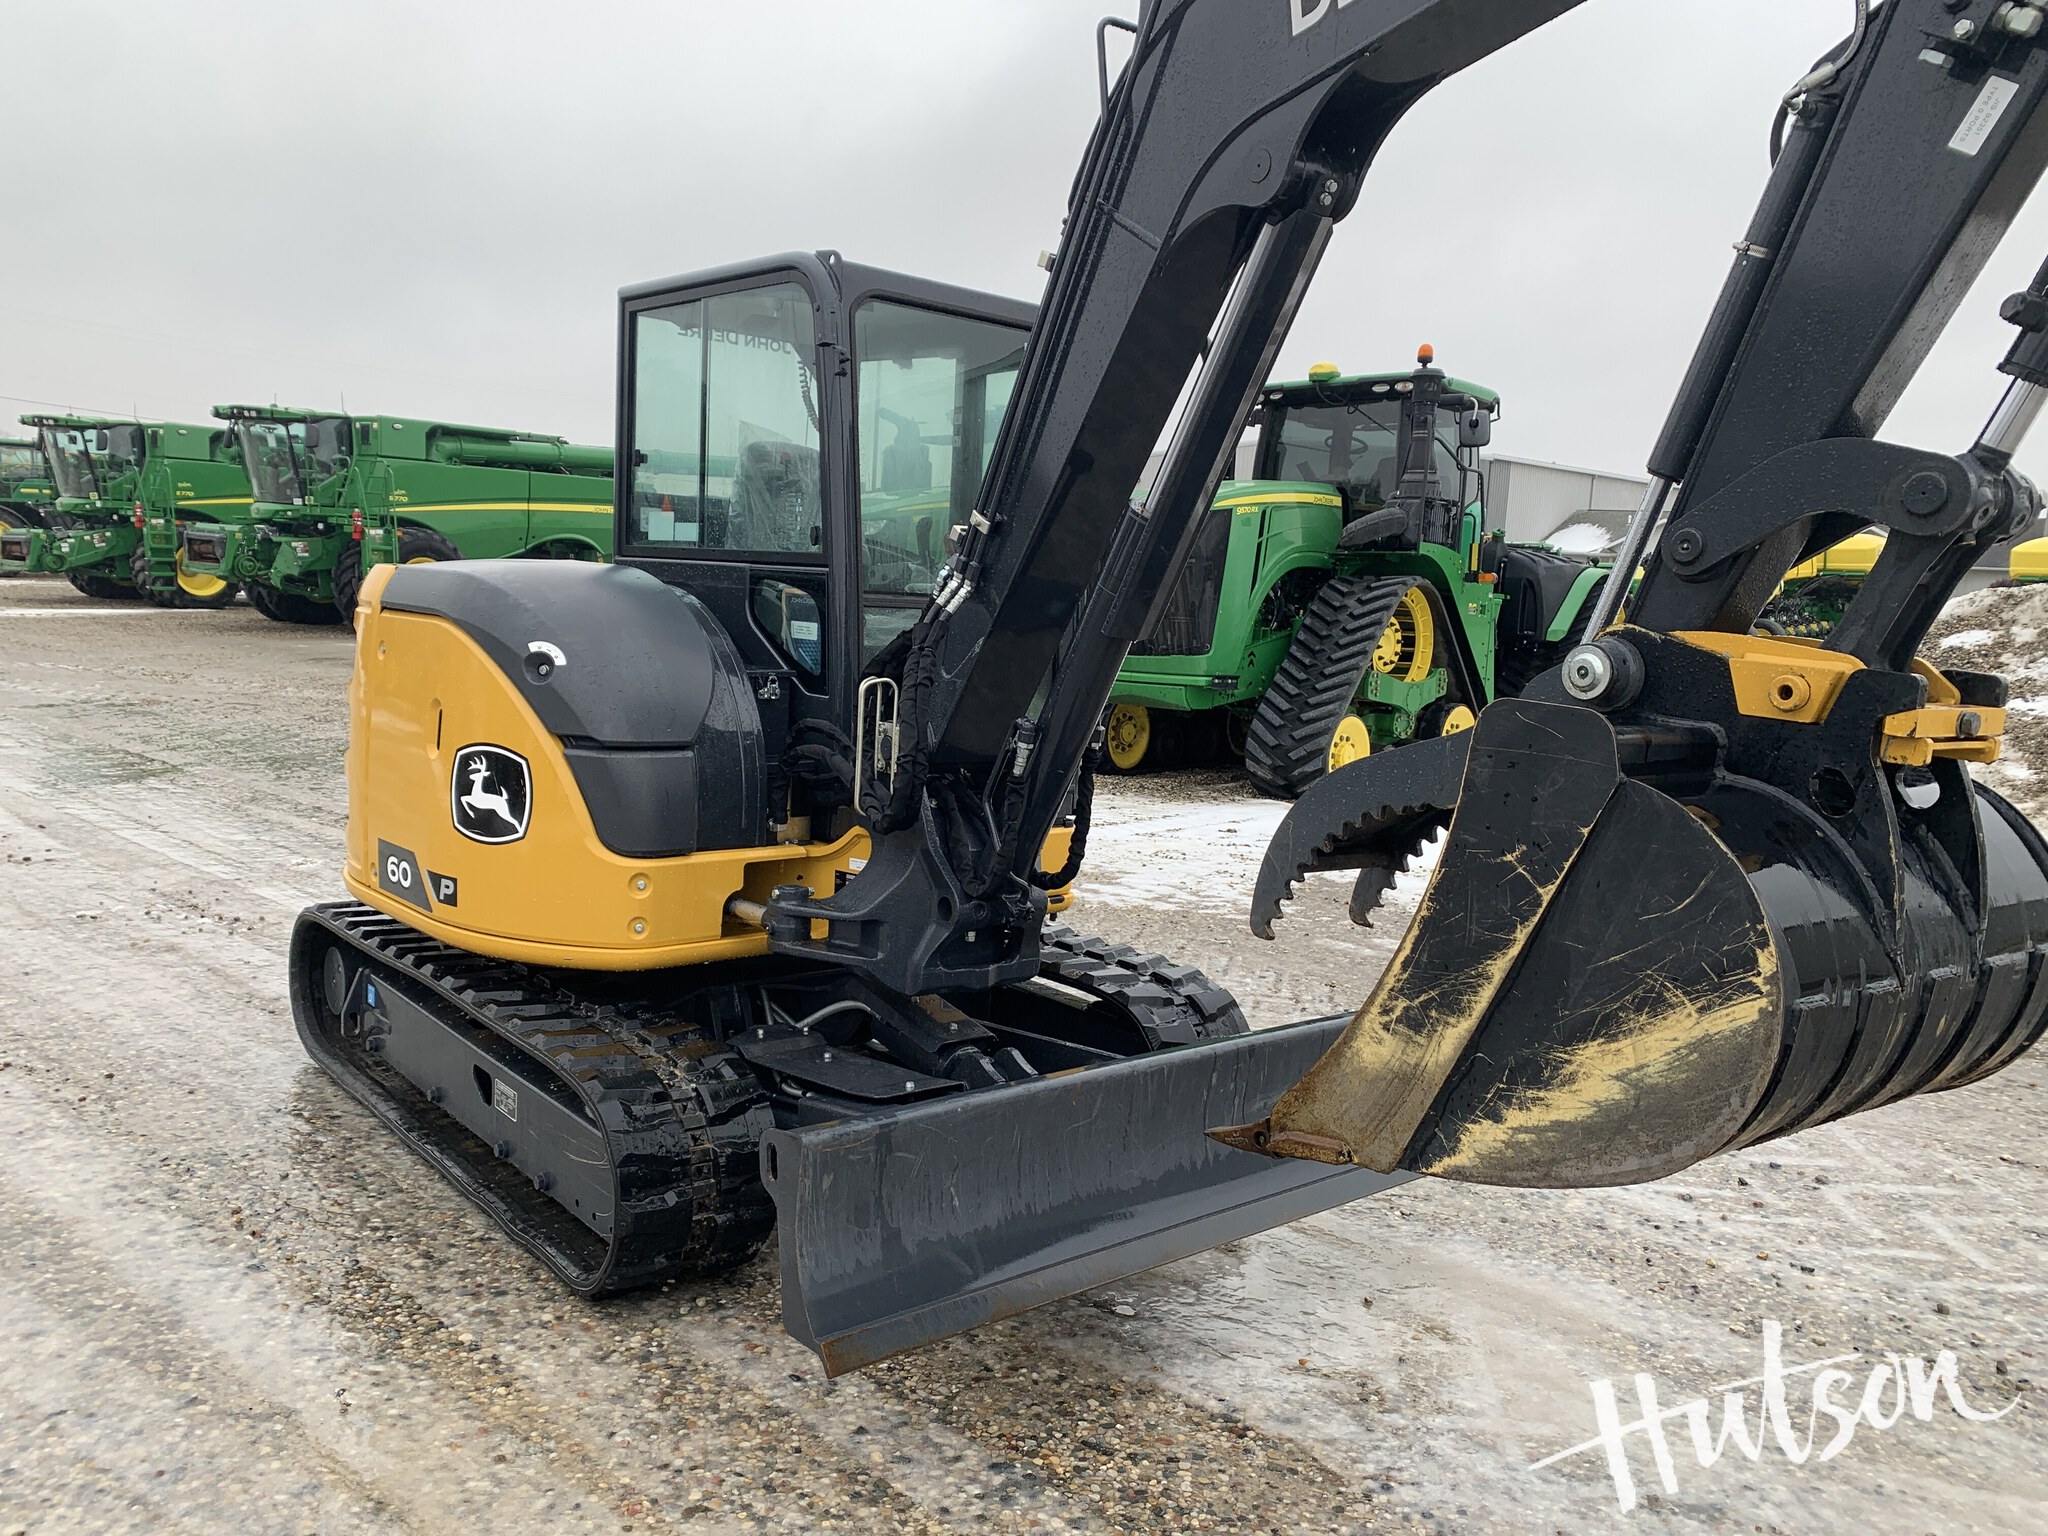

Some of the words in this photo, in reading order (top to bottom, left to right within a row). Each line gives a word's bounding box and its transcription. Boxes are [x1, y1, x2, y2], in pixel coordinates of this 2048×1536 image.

[1982, 86, 1999, 106] TYPE
[1960, 115, 1980, 142] PORTS
[387, 856, 411, 888] 60
[439, 878, 455, 900] P
